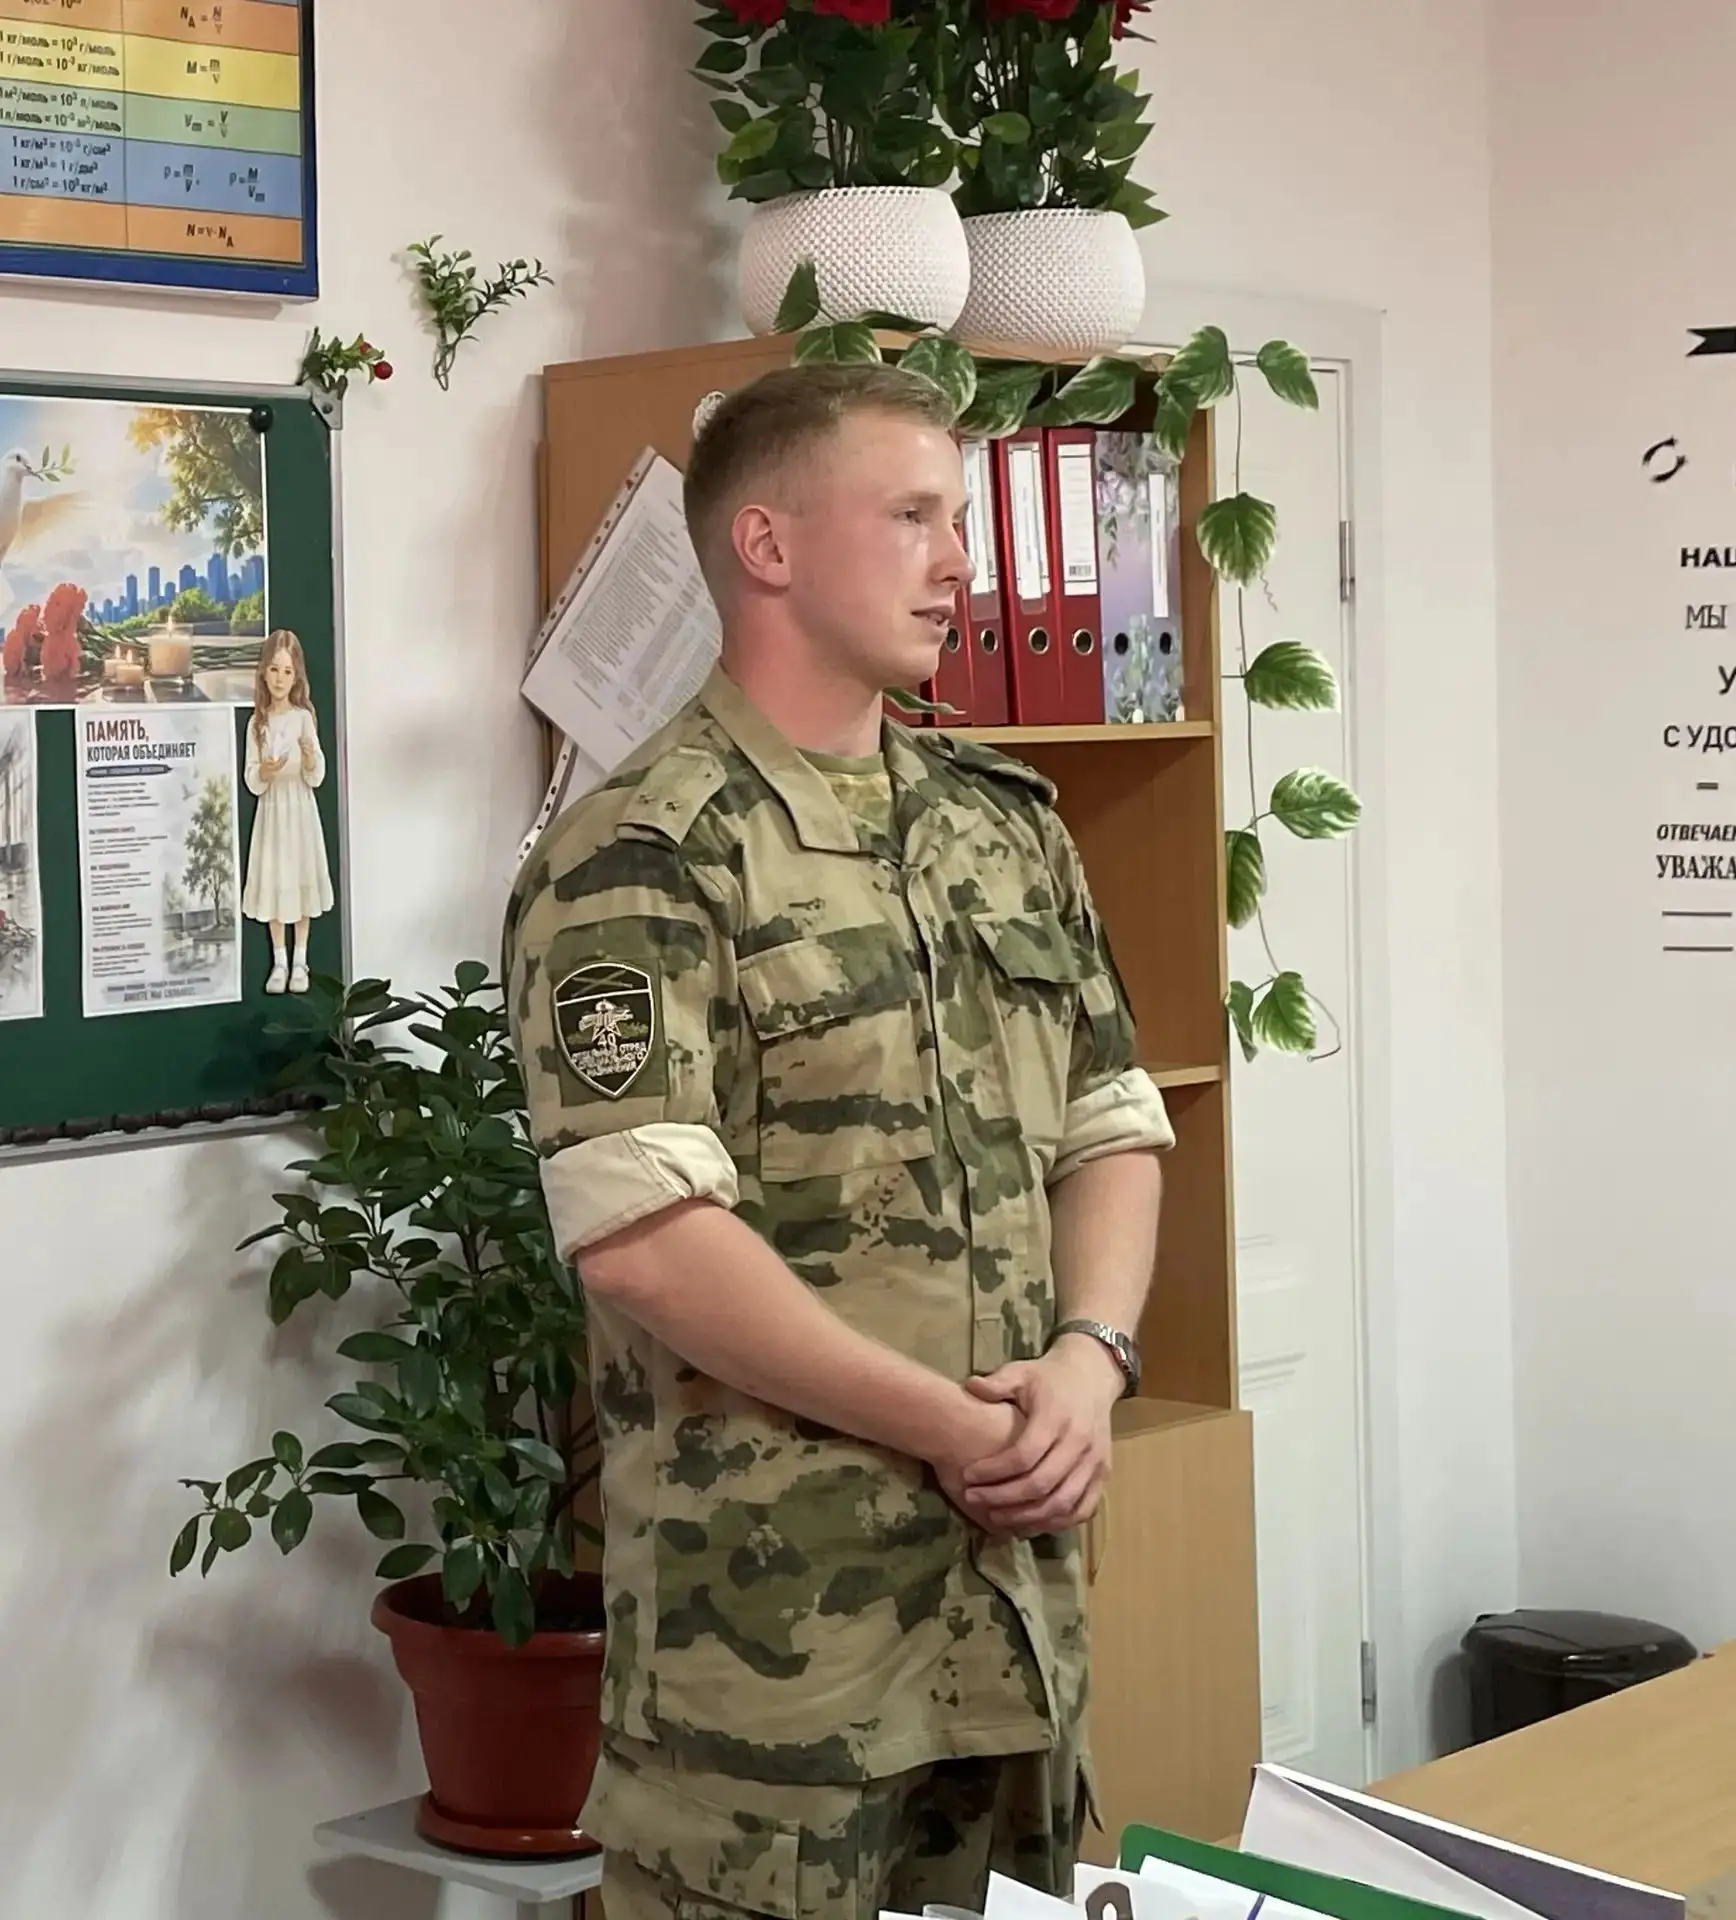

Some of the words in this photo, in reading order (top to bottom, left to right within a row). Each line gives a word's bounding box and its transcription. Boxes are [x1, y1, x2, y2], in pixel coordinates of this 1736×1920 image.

[1685, 604, 1728, 629] МЫ
[86, 719, 149, 742] ПАМЯТЬ,
[1664, 725, 1680, 747] С
[87, 745, 130, 762] КОТОРАЯ
[132, 742, 196, 760] ОБЪЕДИНЯЕТ
